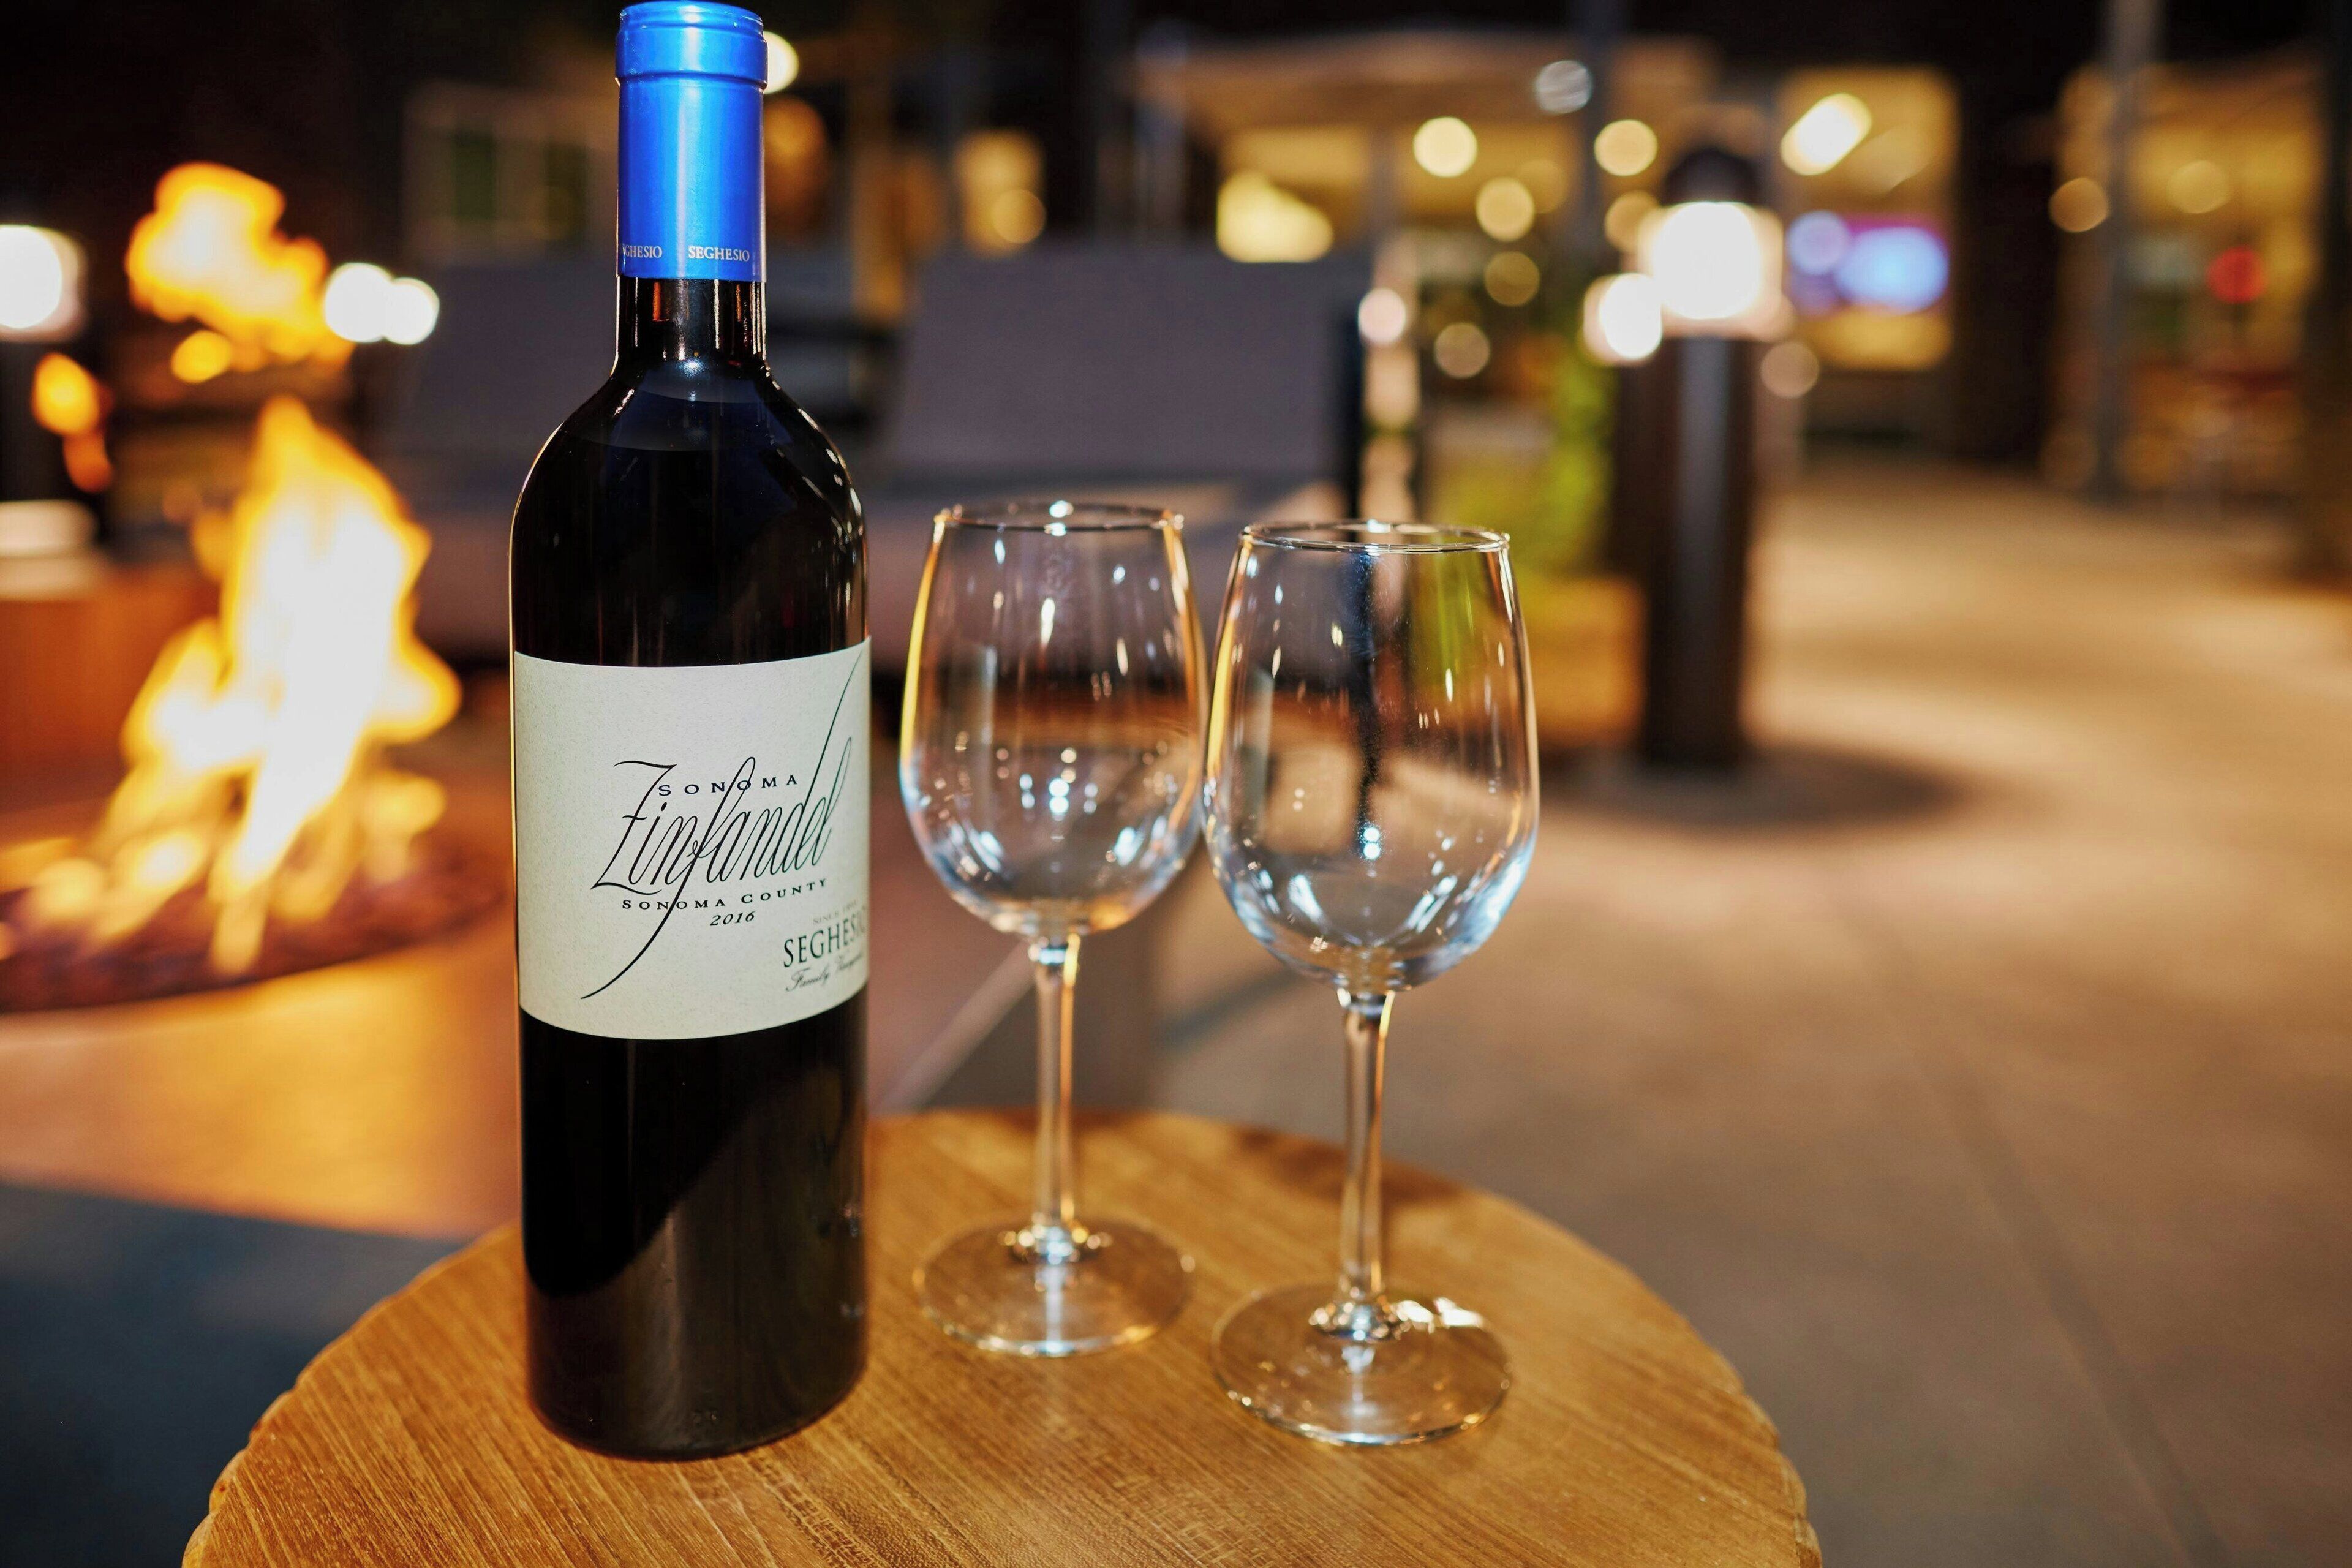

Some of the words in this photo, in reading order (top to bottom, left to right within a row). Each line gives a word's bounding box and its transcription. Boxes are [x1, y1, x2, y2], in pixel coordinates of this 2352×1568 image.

[622, 243, 663, 258] GHESIO
[688, 246, 750, 262] SEGHESIO
[658, 774, 797, 796] SONOMA
[581, 649, 862, 999] Zinfandel
[622, 899, 725, 910] SONOMA
[741, 878, 827, 903] COUNTY
[710, 911, 756, 926] 2016
[783, 905, 867, 968] SEGHES
